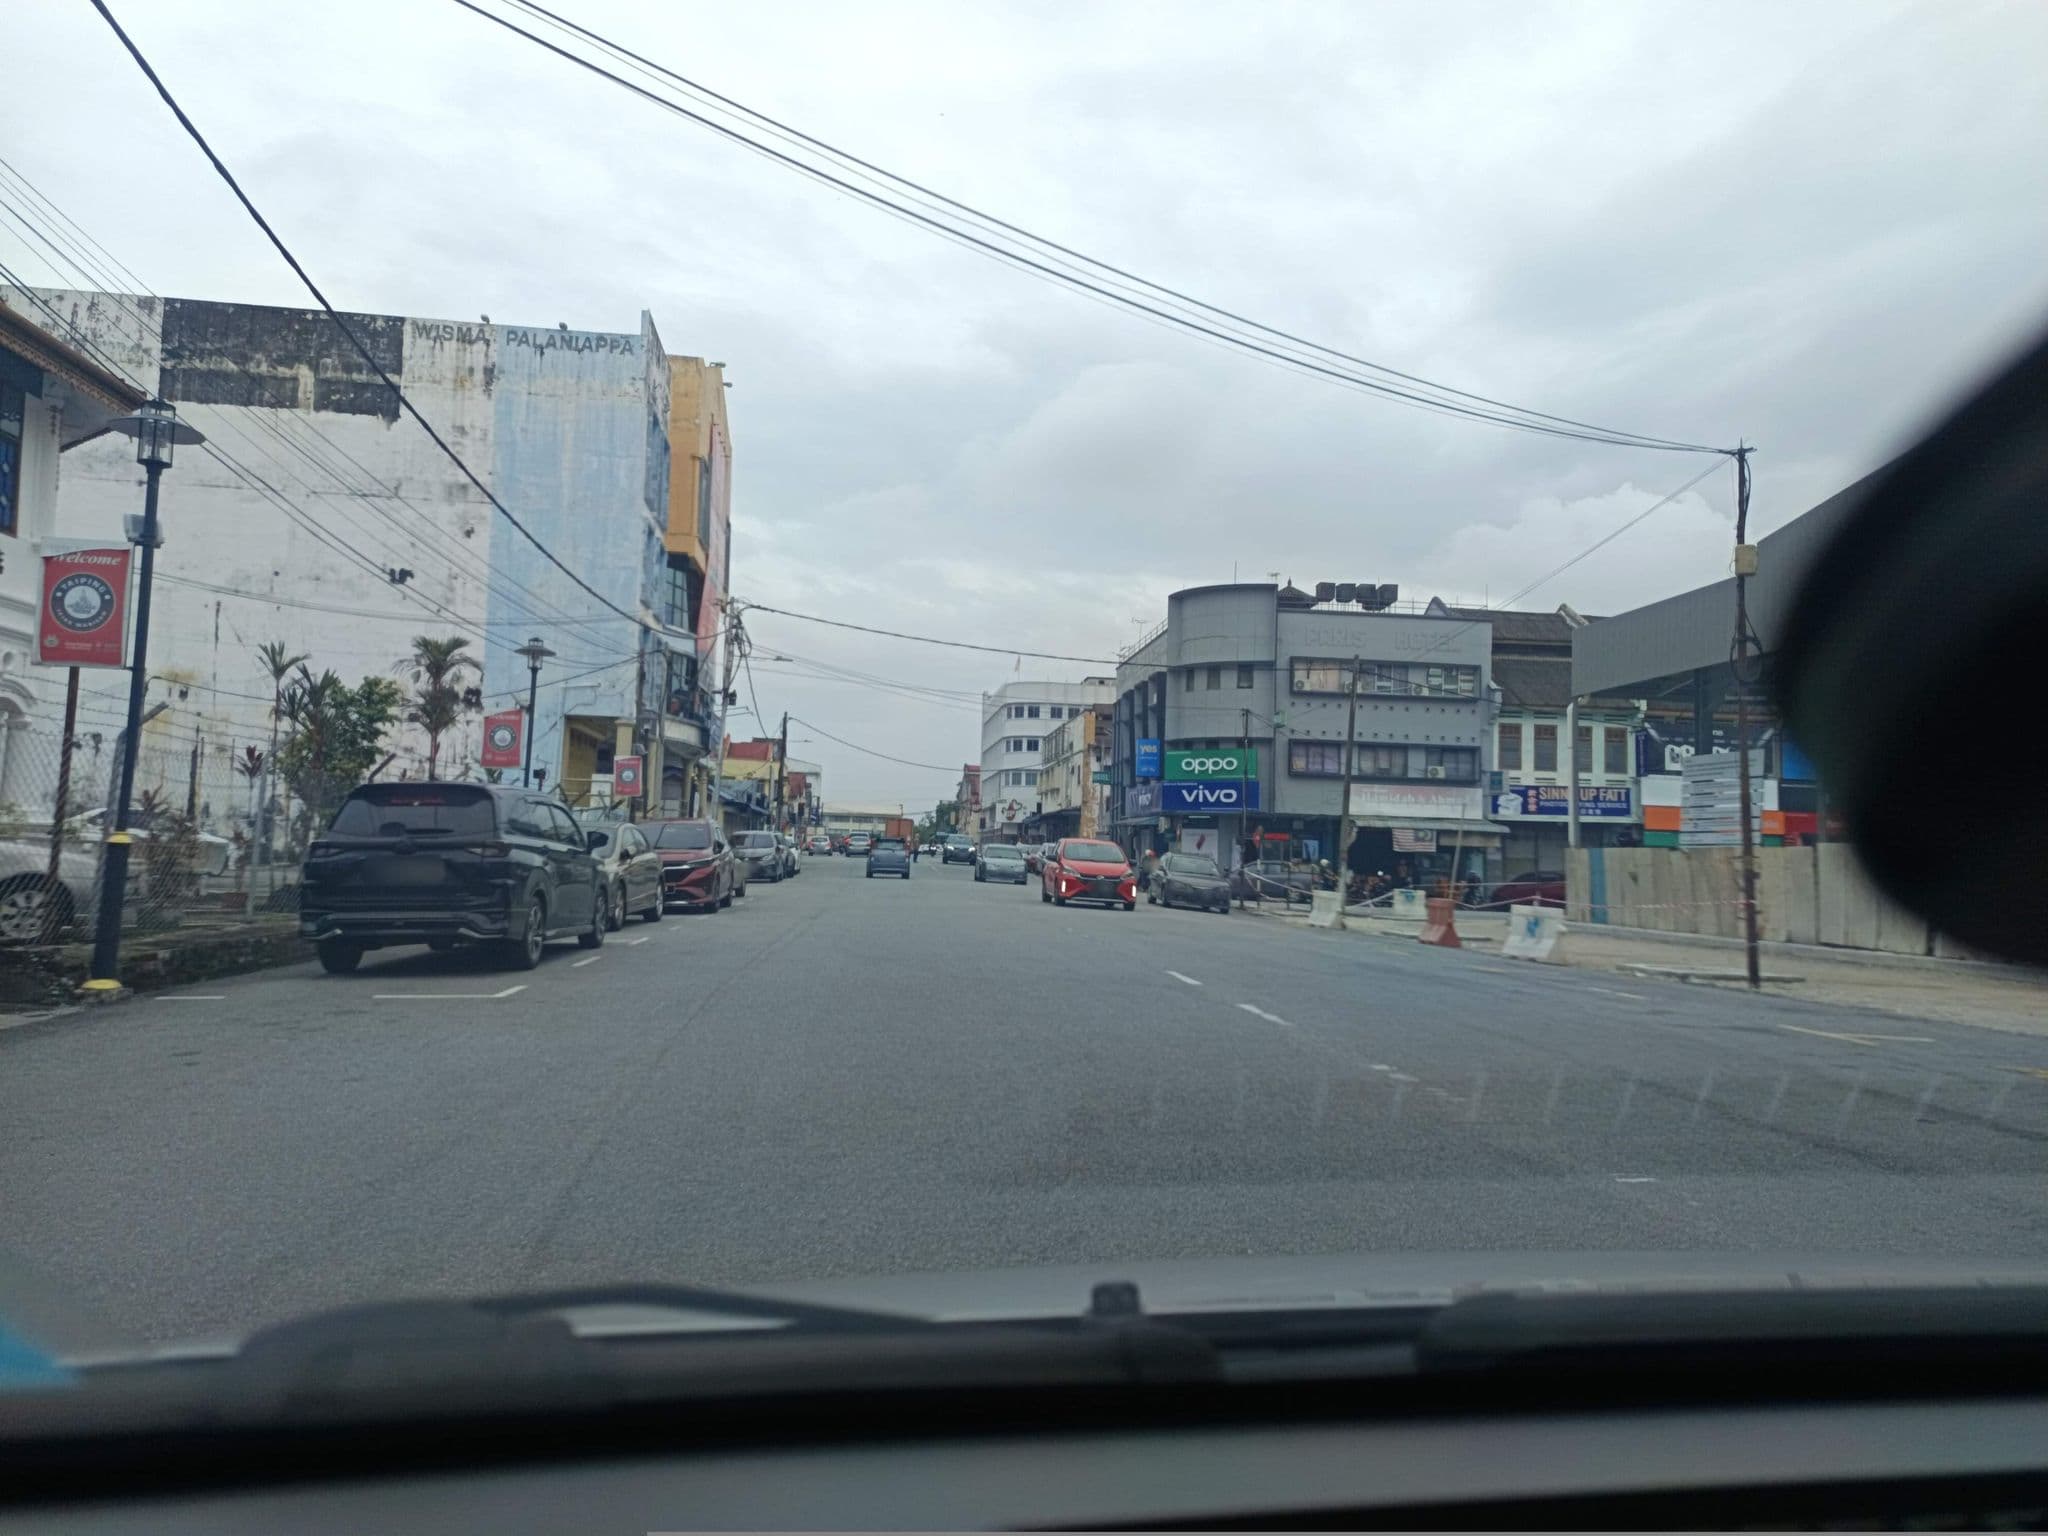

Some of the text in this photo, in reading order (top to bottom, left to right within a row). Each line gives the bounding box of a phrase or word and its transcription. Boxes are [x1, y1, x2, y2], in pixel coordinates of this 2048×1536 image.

[415, 322, 634, 355] WISMA PALANIAPPA
[1181, 757, 1238, 774] oppo
[1181, 784, 1238, 803] vivo
[1579, 789, 1597, 801] UP
[1599, 789, 1627, 801] FATT
